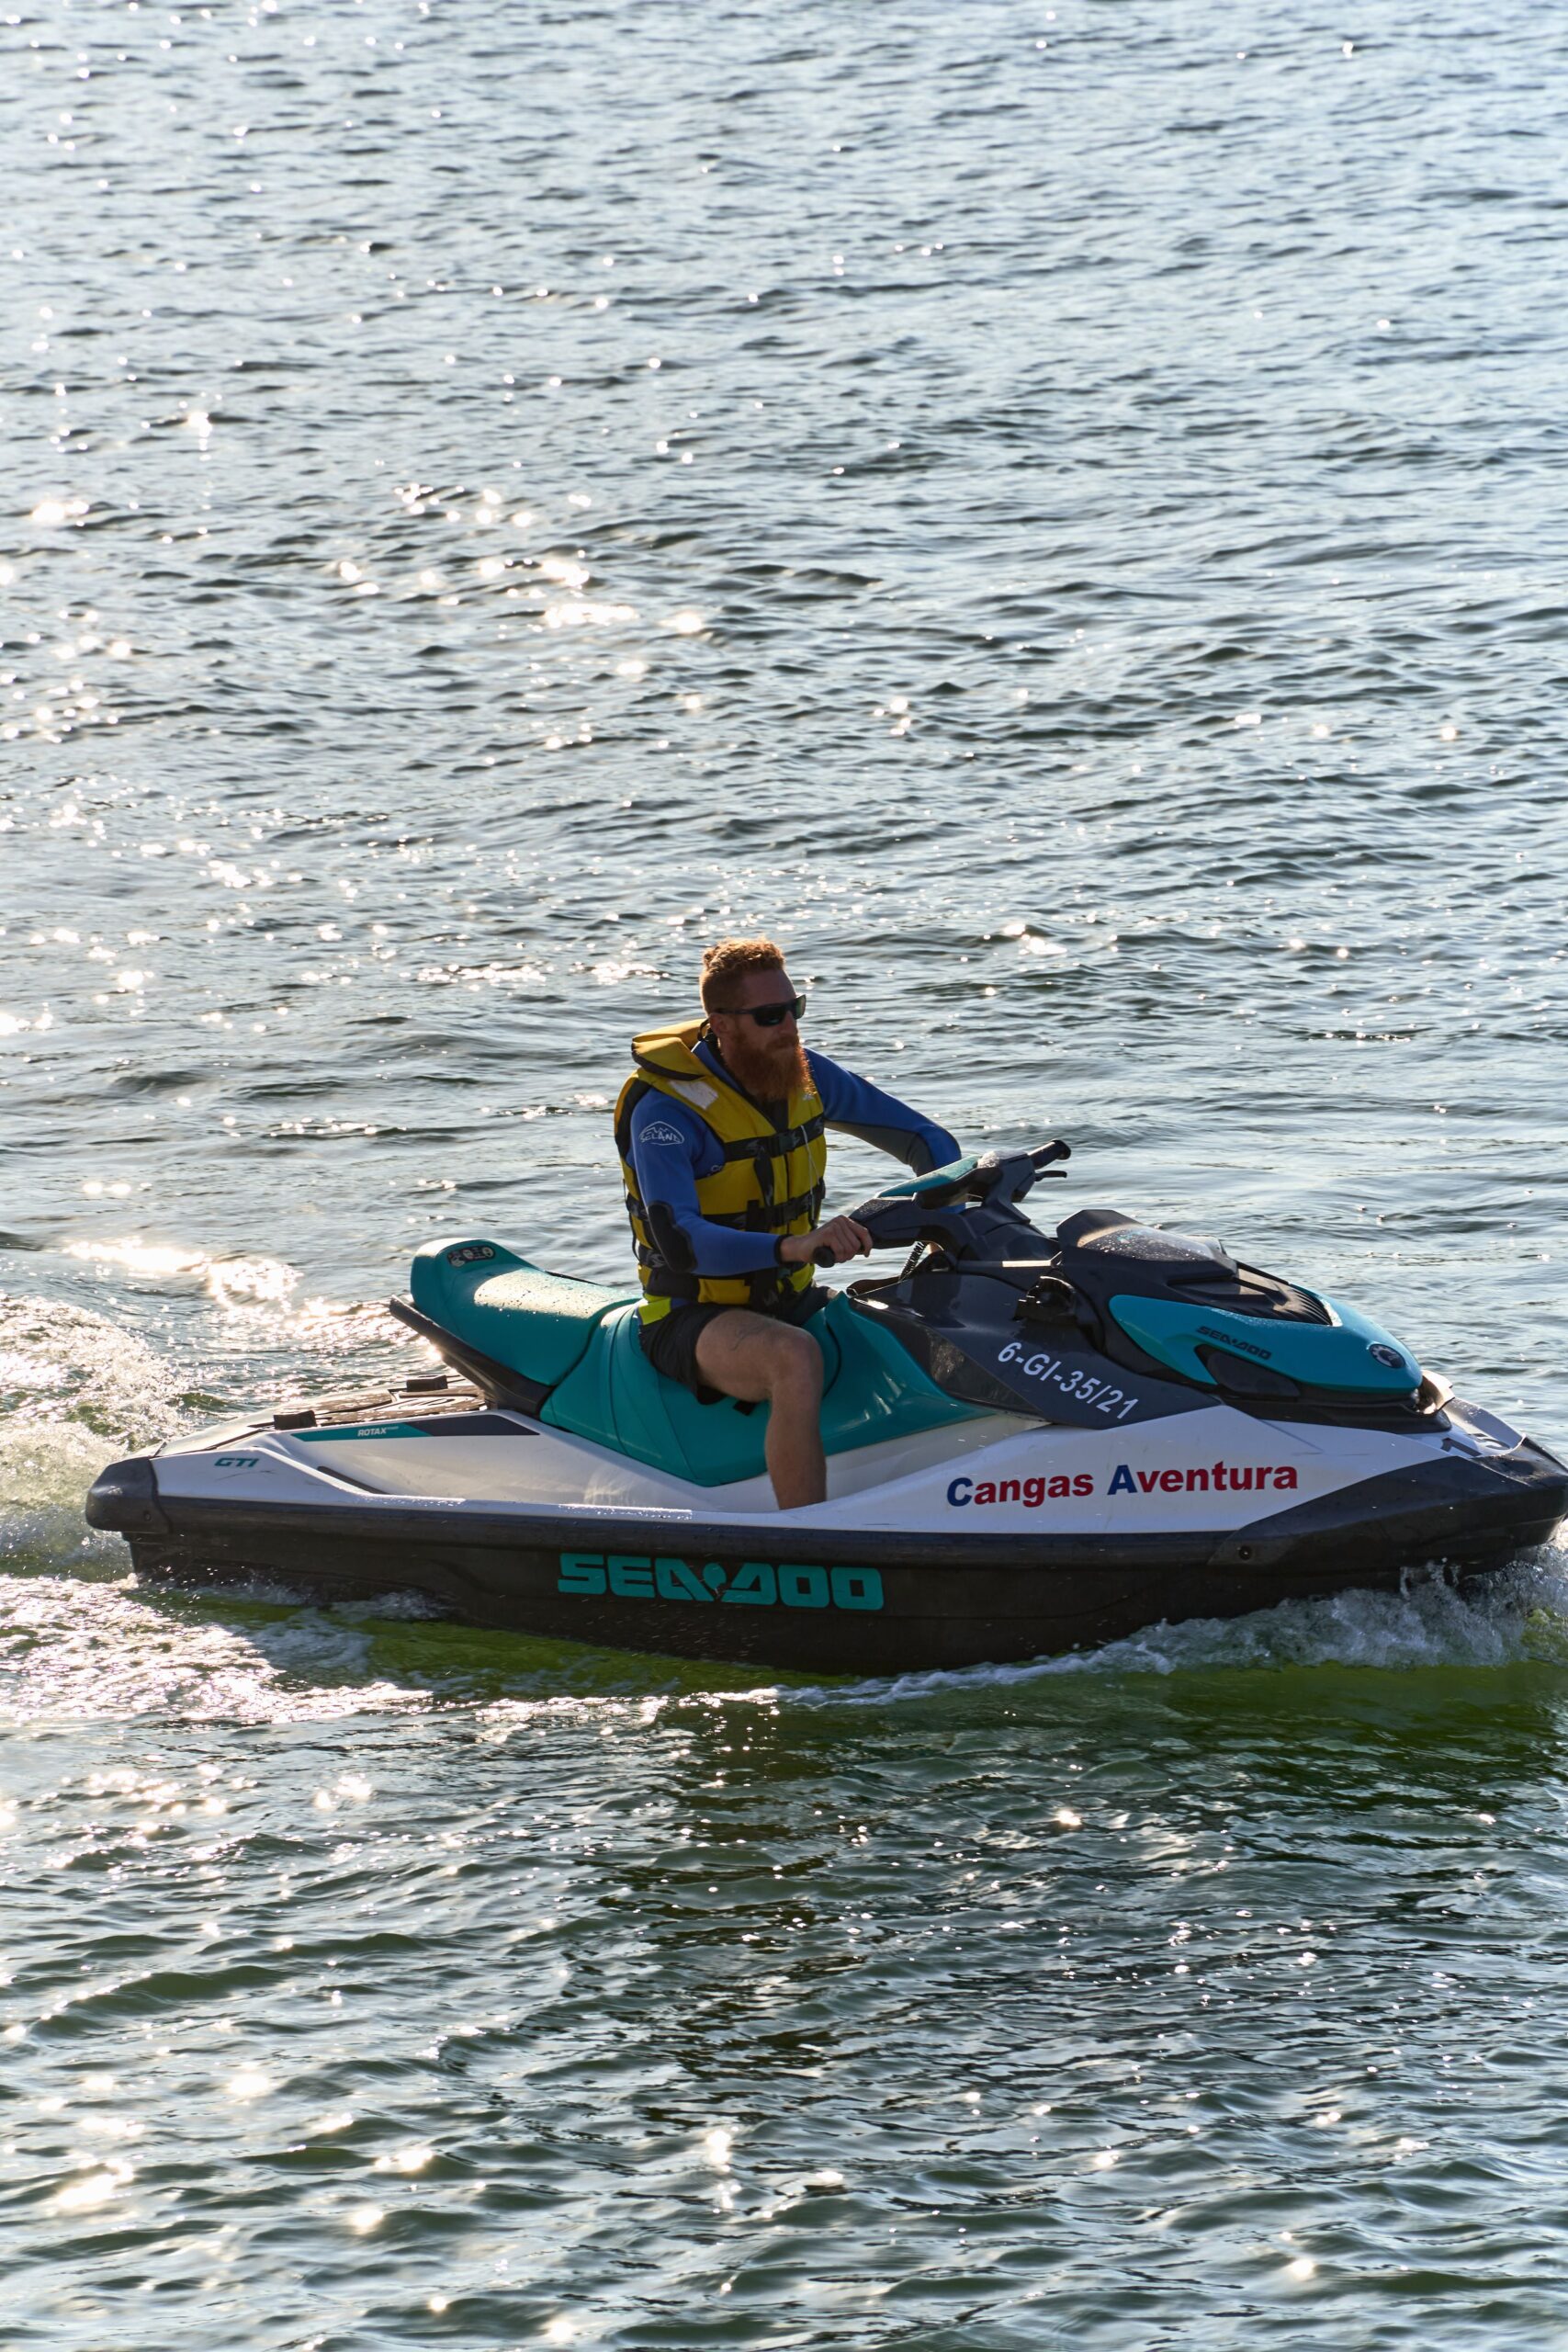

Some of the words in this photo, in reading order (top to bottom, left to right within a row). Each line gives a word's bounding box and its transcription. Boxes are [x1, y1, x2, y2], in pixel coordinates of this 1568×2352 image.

[998, 1342, 1139, 1419] 6-GI-35/21
[357, 1427, 387, 1437] ROTAX
[214, 1457, 260, 1467] GTI
[946, 1474, 1094, 1507] Cangas
[1107, 1461, 1299, 1496] Aventura
